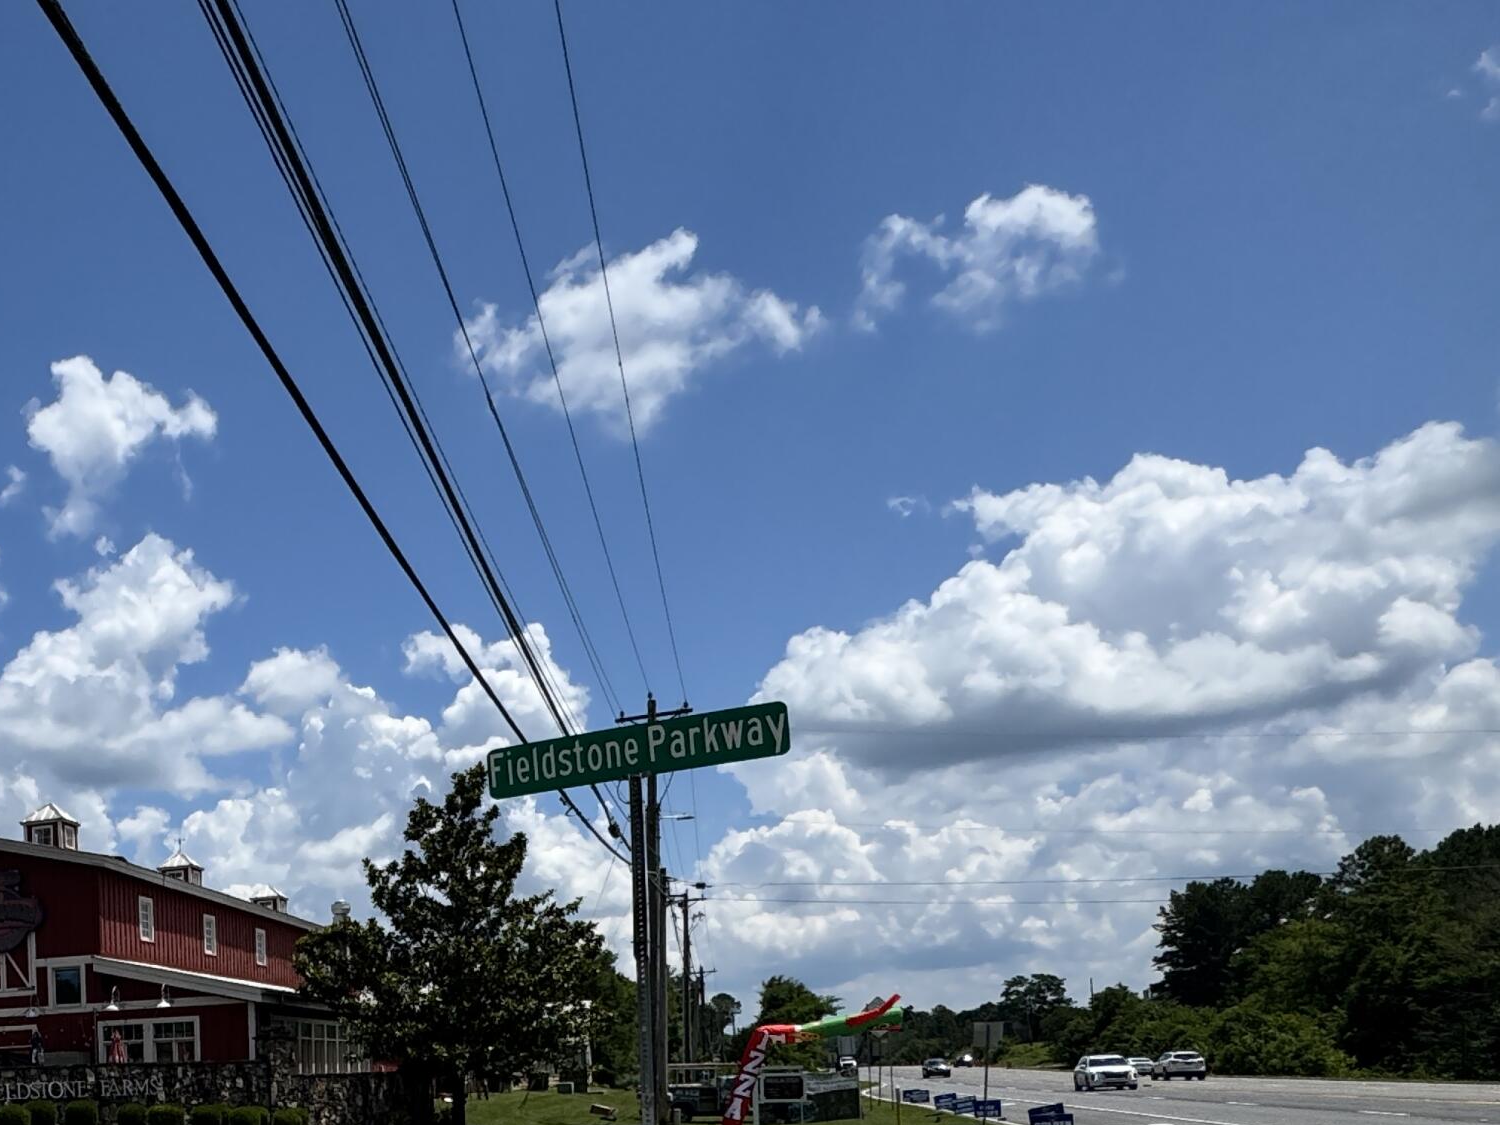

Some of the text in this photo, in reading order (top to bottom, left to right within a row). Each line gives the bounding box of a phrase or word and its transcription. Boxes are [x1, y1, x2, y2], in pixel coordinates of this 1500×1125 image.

[487, 712, 786, 788] Fieldstone Parkway
[100, 1078, 158, 1097] FARMS
